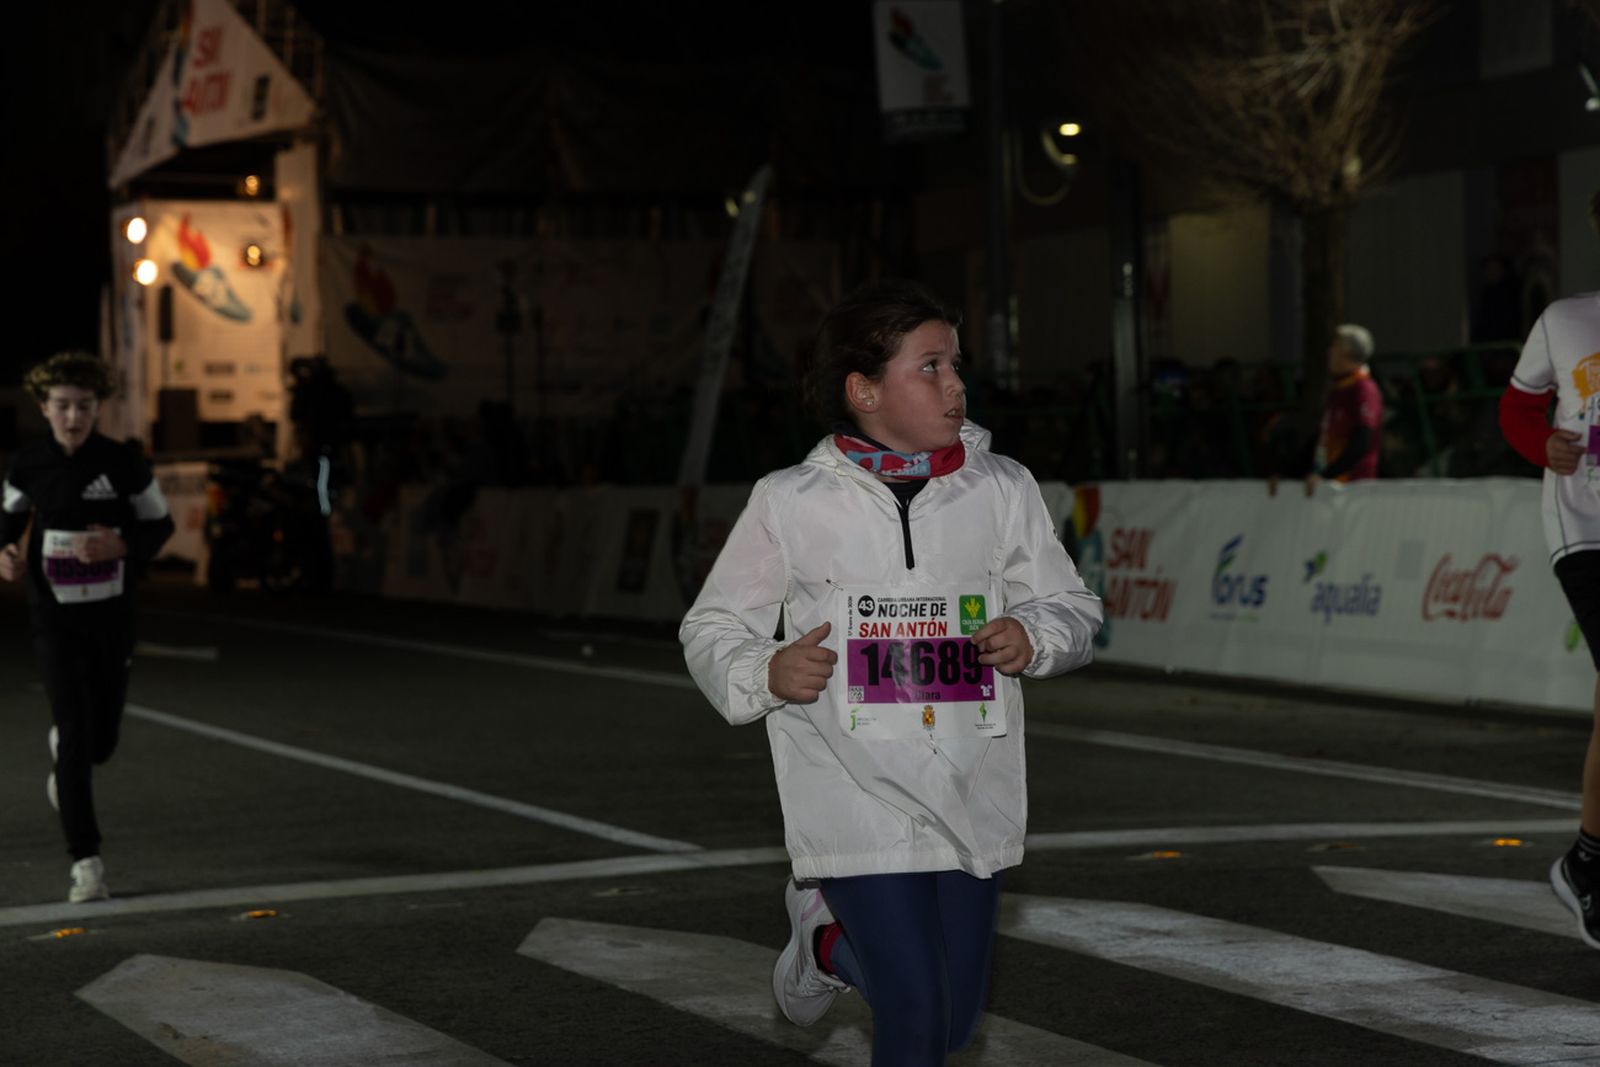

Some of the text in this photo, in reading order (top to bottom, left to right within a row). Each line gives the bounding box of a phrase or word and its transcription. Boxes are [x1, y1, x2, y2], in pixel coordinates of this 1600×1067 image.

[1107, 528, 1153, 570] SAN
[878, 602, 947, 617] NOCHE DE
[859, 617, 948, 638] SAN ANTÓN
[860, 641, 983, 686] 14689
